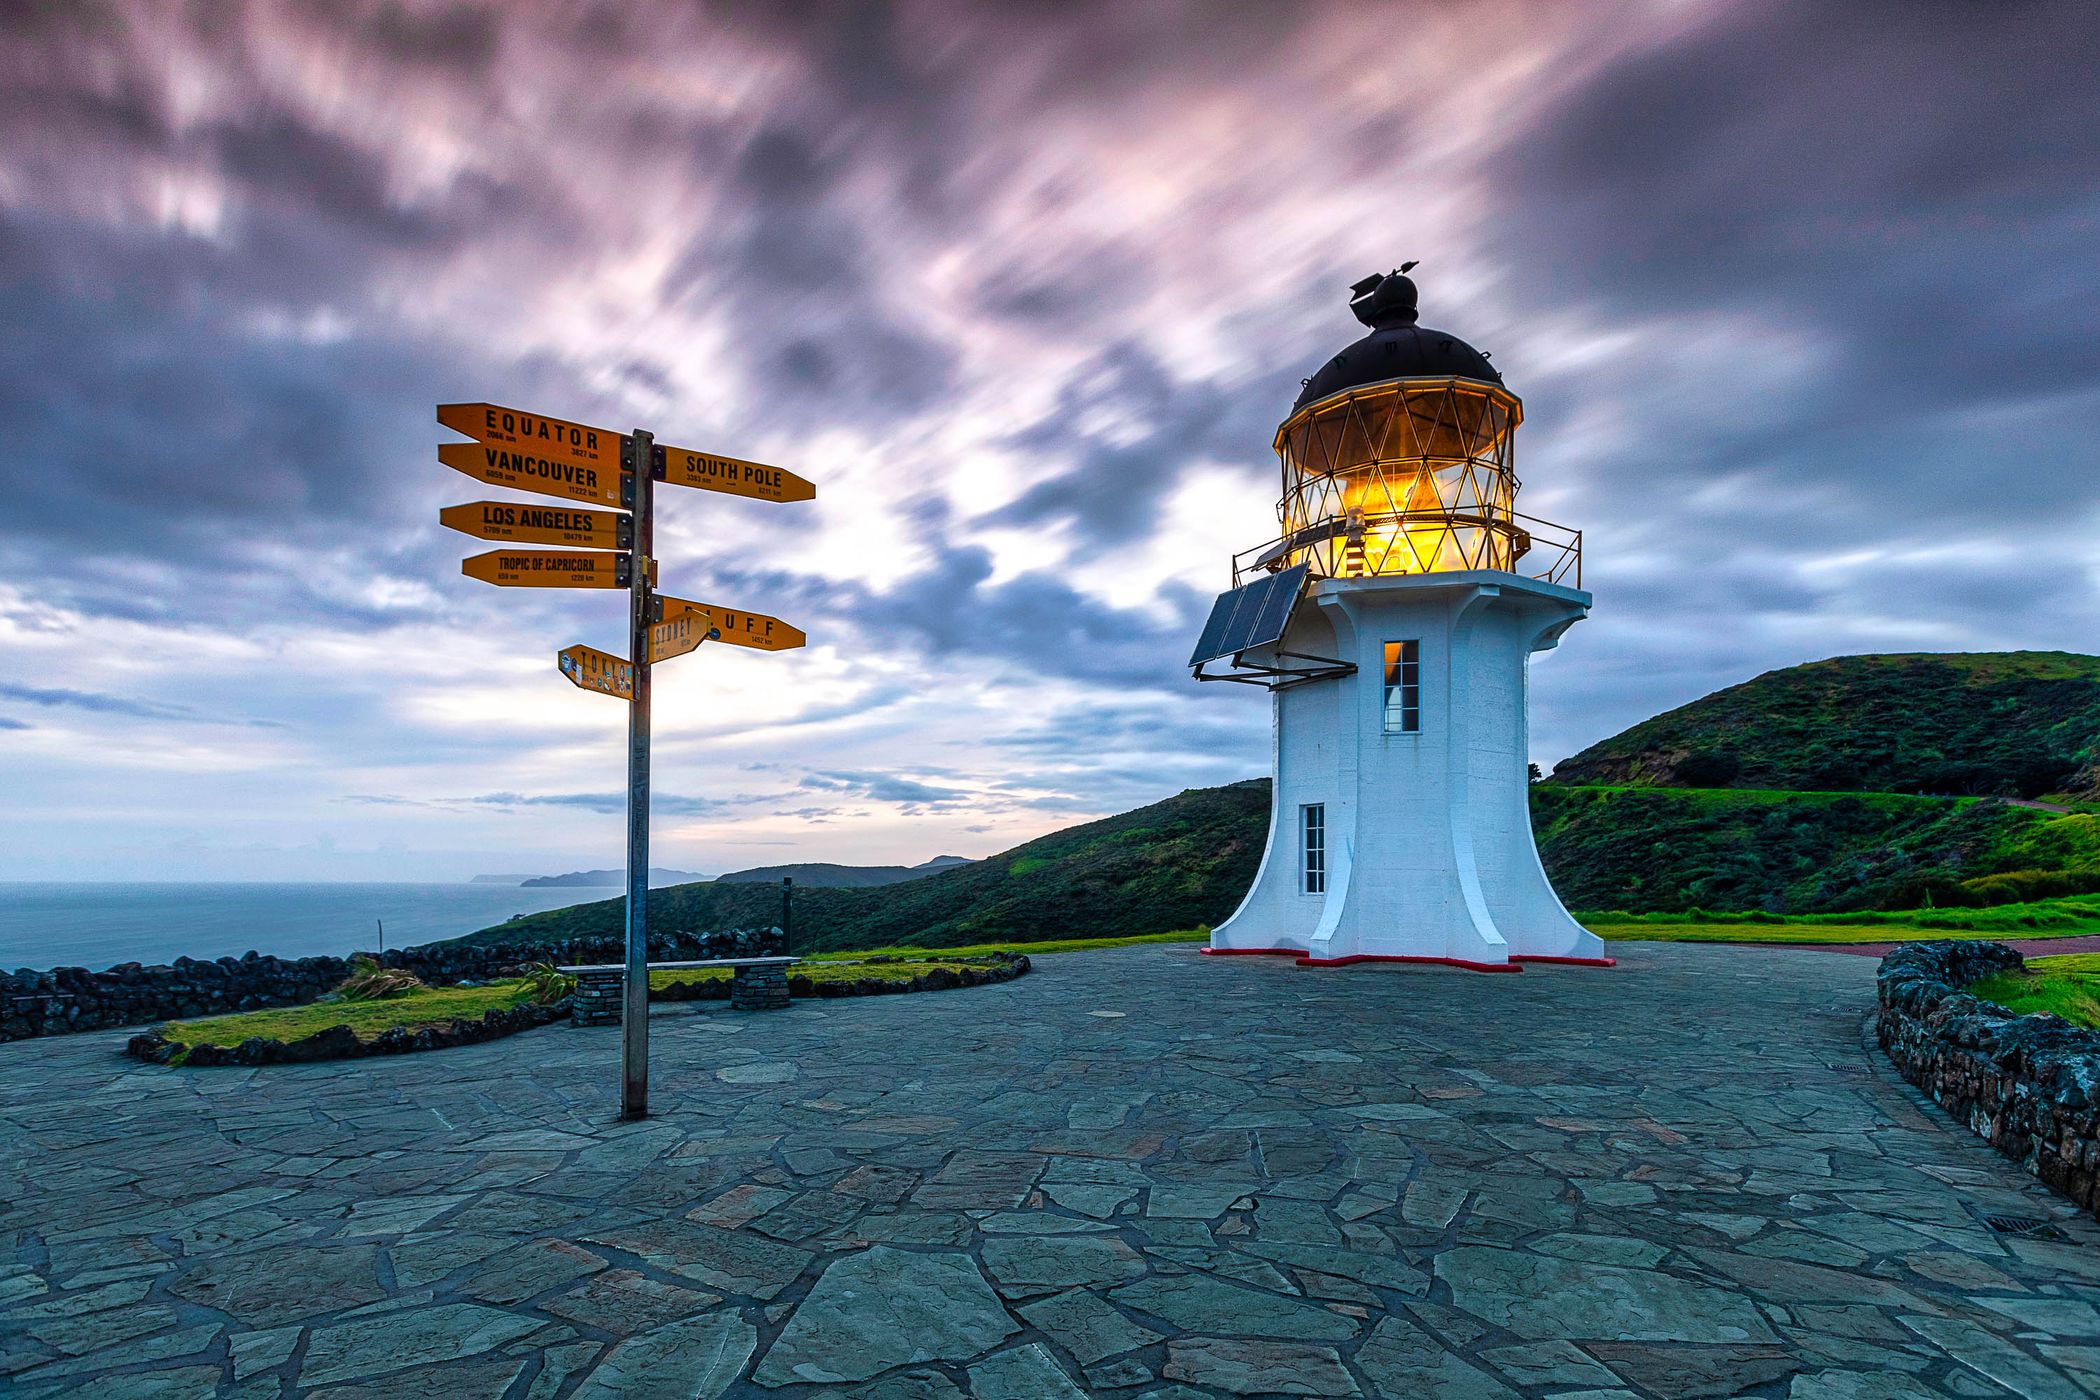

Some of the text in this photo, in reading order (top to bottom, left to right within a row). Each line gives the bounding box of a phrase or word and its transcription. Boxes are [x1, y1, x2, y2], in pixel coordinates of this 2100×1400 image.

[486, 410, 598, 450] EQUATOR
[485, 448, 597, 488] VANCOUVER
[687, 456, 782, 488] SOUTH POLE
[588, 489, 598, 497] km
[483, 506, 593, 532] LOS ANGELES
[499, 557, 594, 571] TROPIC OF CAPRICORN
[656, 616, 691, 645] SYDNEY
[685, 606, 773, 636] UFF
